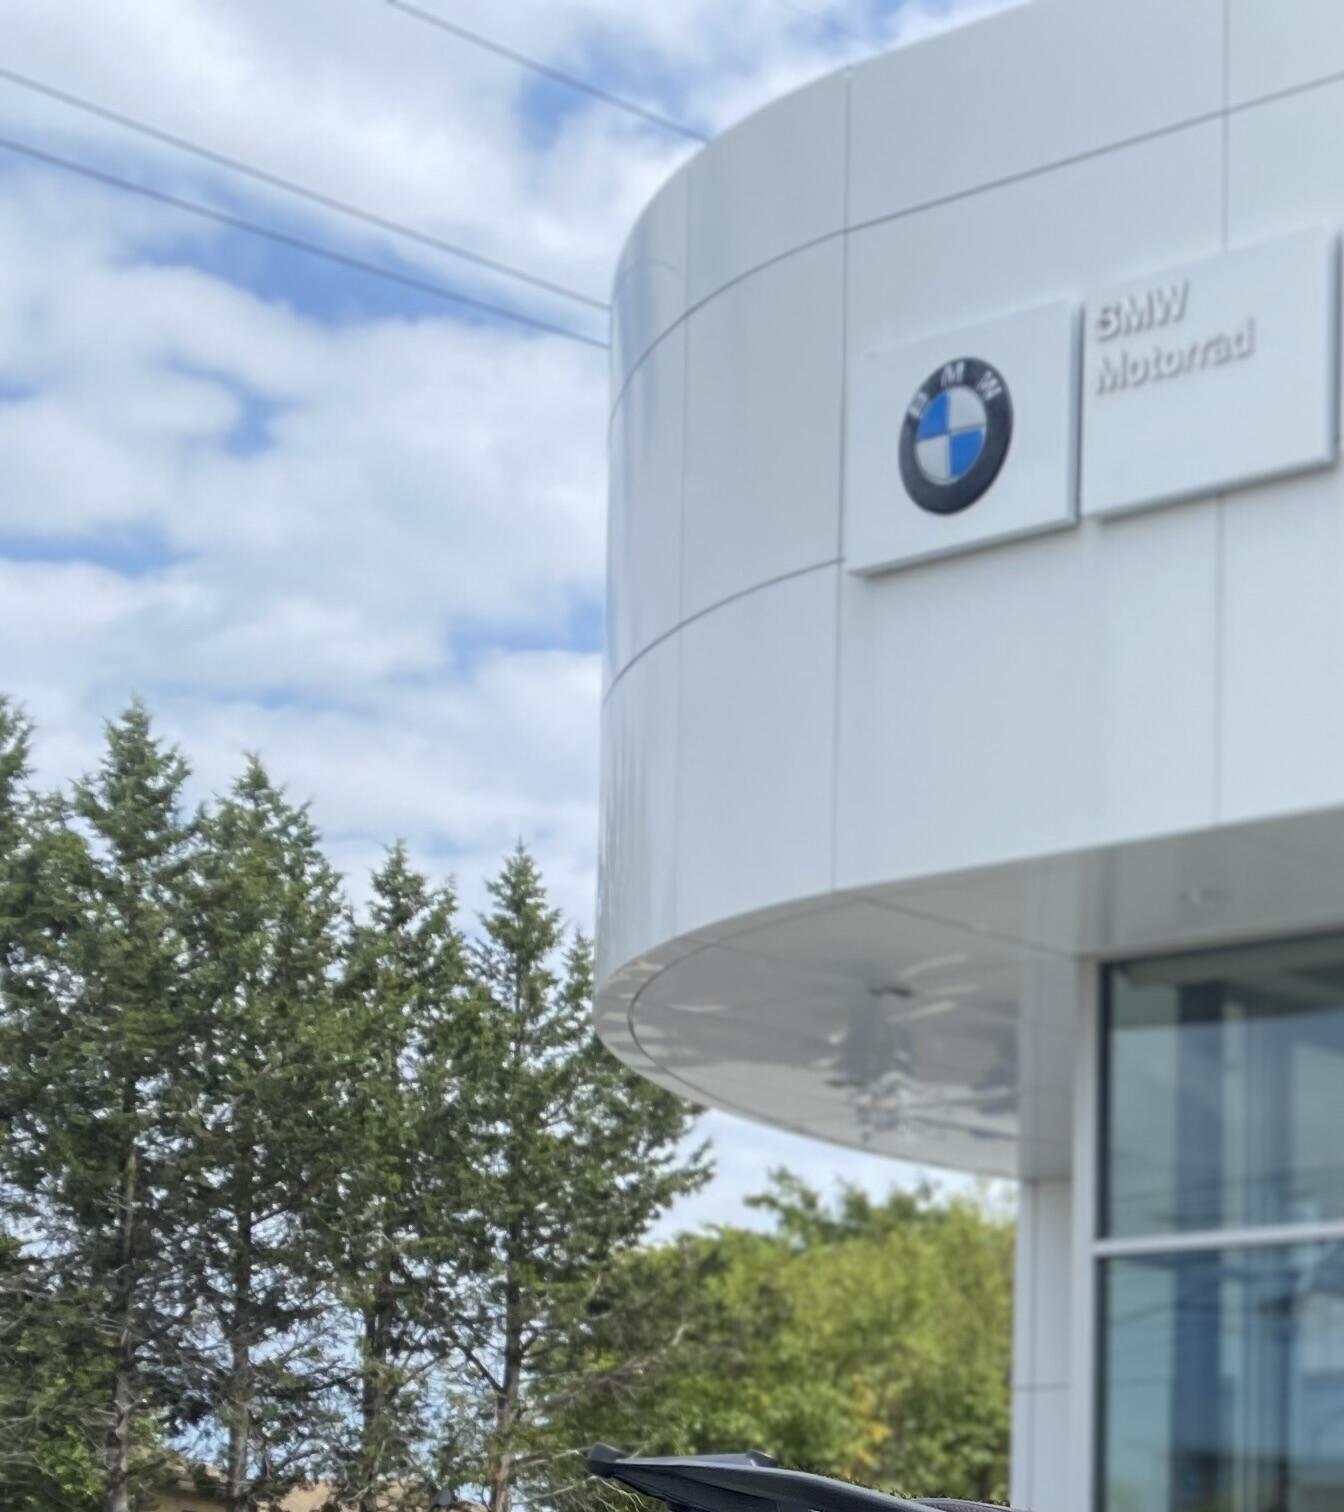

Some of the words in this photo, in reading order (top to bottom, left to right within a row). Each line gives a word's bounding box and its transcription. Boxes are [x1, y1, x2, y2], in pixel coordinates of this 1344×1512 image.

[1096, 281, 1189, 342] BMW
[1096, 318, 1256, 395] Motorrad
[908, 360, 1002, 419] BMW
